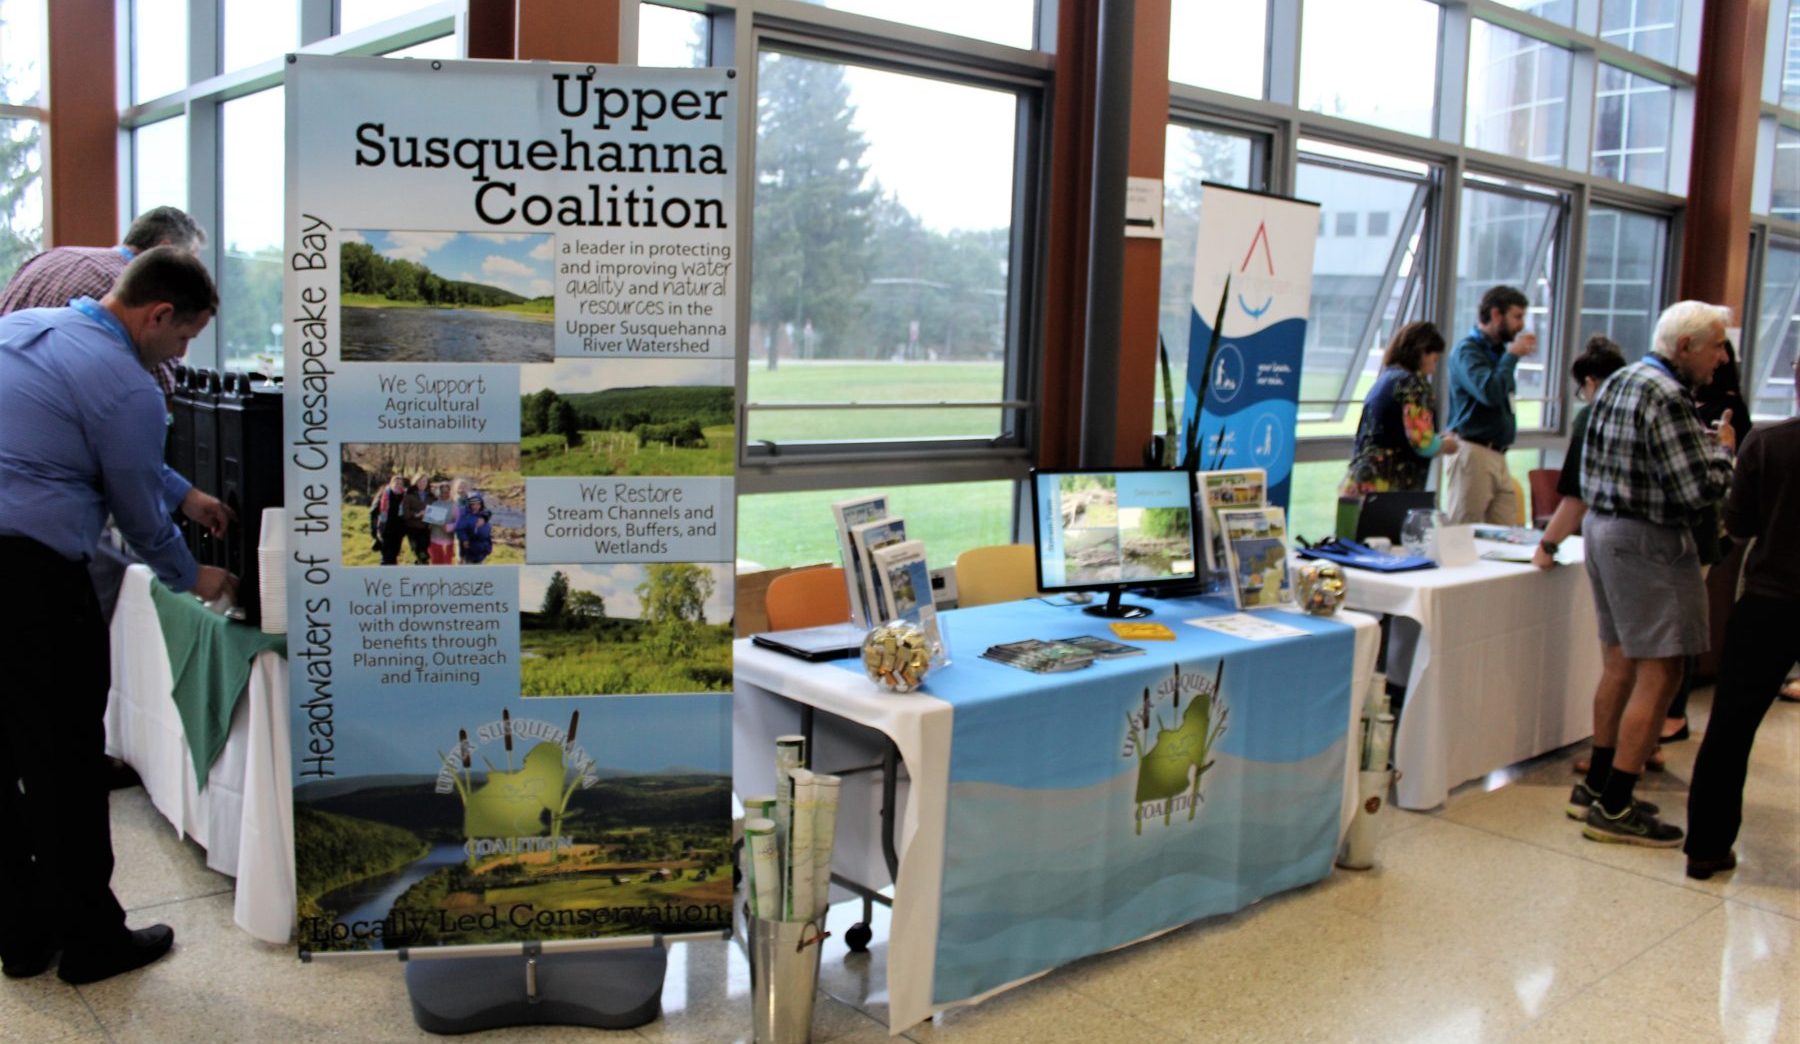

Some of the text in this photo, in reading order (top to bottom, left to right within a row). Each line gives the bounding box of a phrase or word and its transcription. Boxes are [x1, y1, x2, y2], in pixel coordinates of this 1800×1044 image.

[552, 73, 728, 130] Upper
[355, 122, 728, 181] Susquehanna
[475, 181, 728, 229] Coalition
[562, 240, 731, 262] a leader in protecting
[560, 259, 731, 279] and improving water
[565, 276, 727, 297] quality and natural
[579, 300, 713, 316] resources in the
[566, 320, 727, 338] Upper Susquehanna
[583, 338, 710, 353] River Watershed
[379, 374, 486, 397] We Support
[384, 398, 480, 415] Agricultural
[377, 414, 487, 433] Sustainability
[292, 213, 336, 778] Headwaters of the Chesapeake Bay
[579, 483, 683, 504] We Restore
[547, 505, 715, 521] Stream Channels and
[544, 522, 717, 539] Corridors, Buffers, and
[595, 539, 669, 555] Wetlands
[364, 579, 495, 600] We Emphasize
[349, 600, 509, 617] local improvements
[358, 617, 500, 634] with downstream
[362, 635, 498, 651] benefits through
[353, 650, 507, 671] Planning, Outreach
[380, 668, 480, 687] and Training
[1156, 672, 1228, 738] SUQUEHNA
[309, 899, 723, 944] Locally Led Conservation
